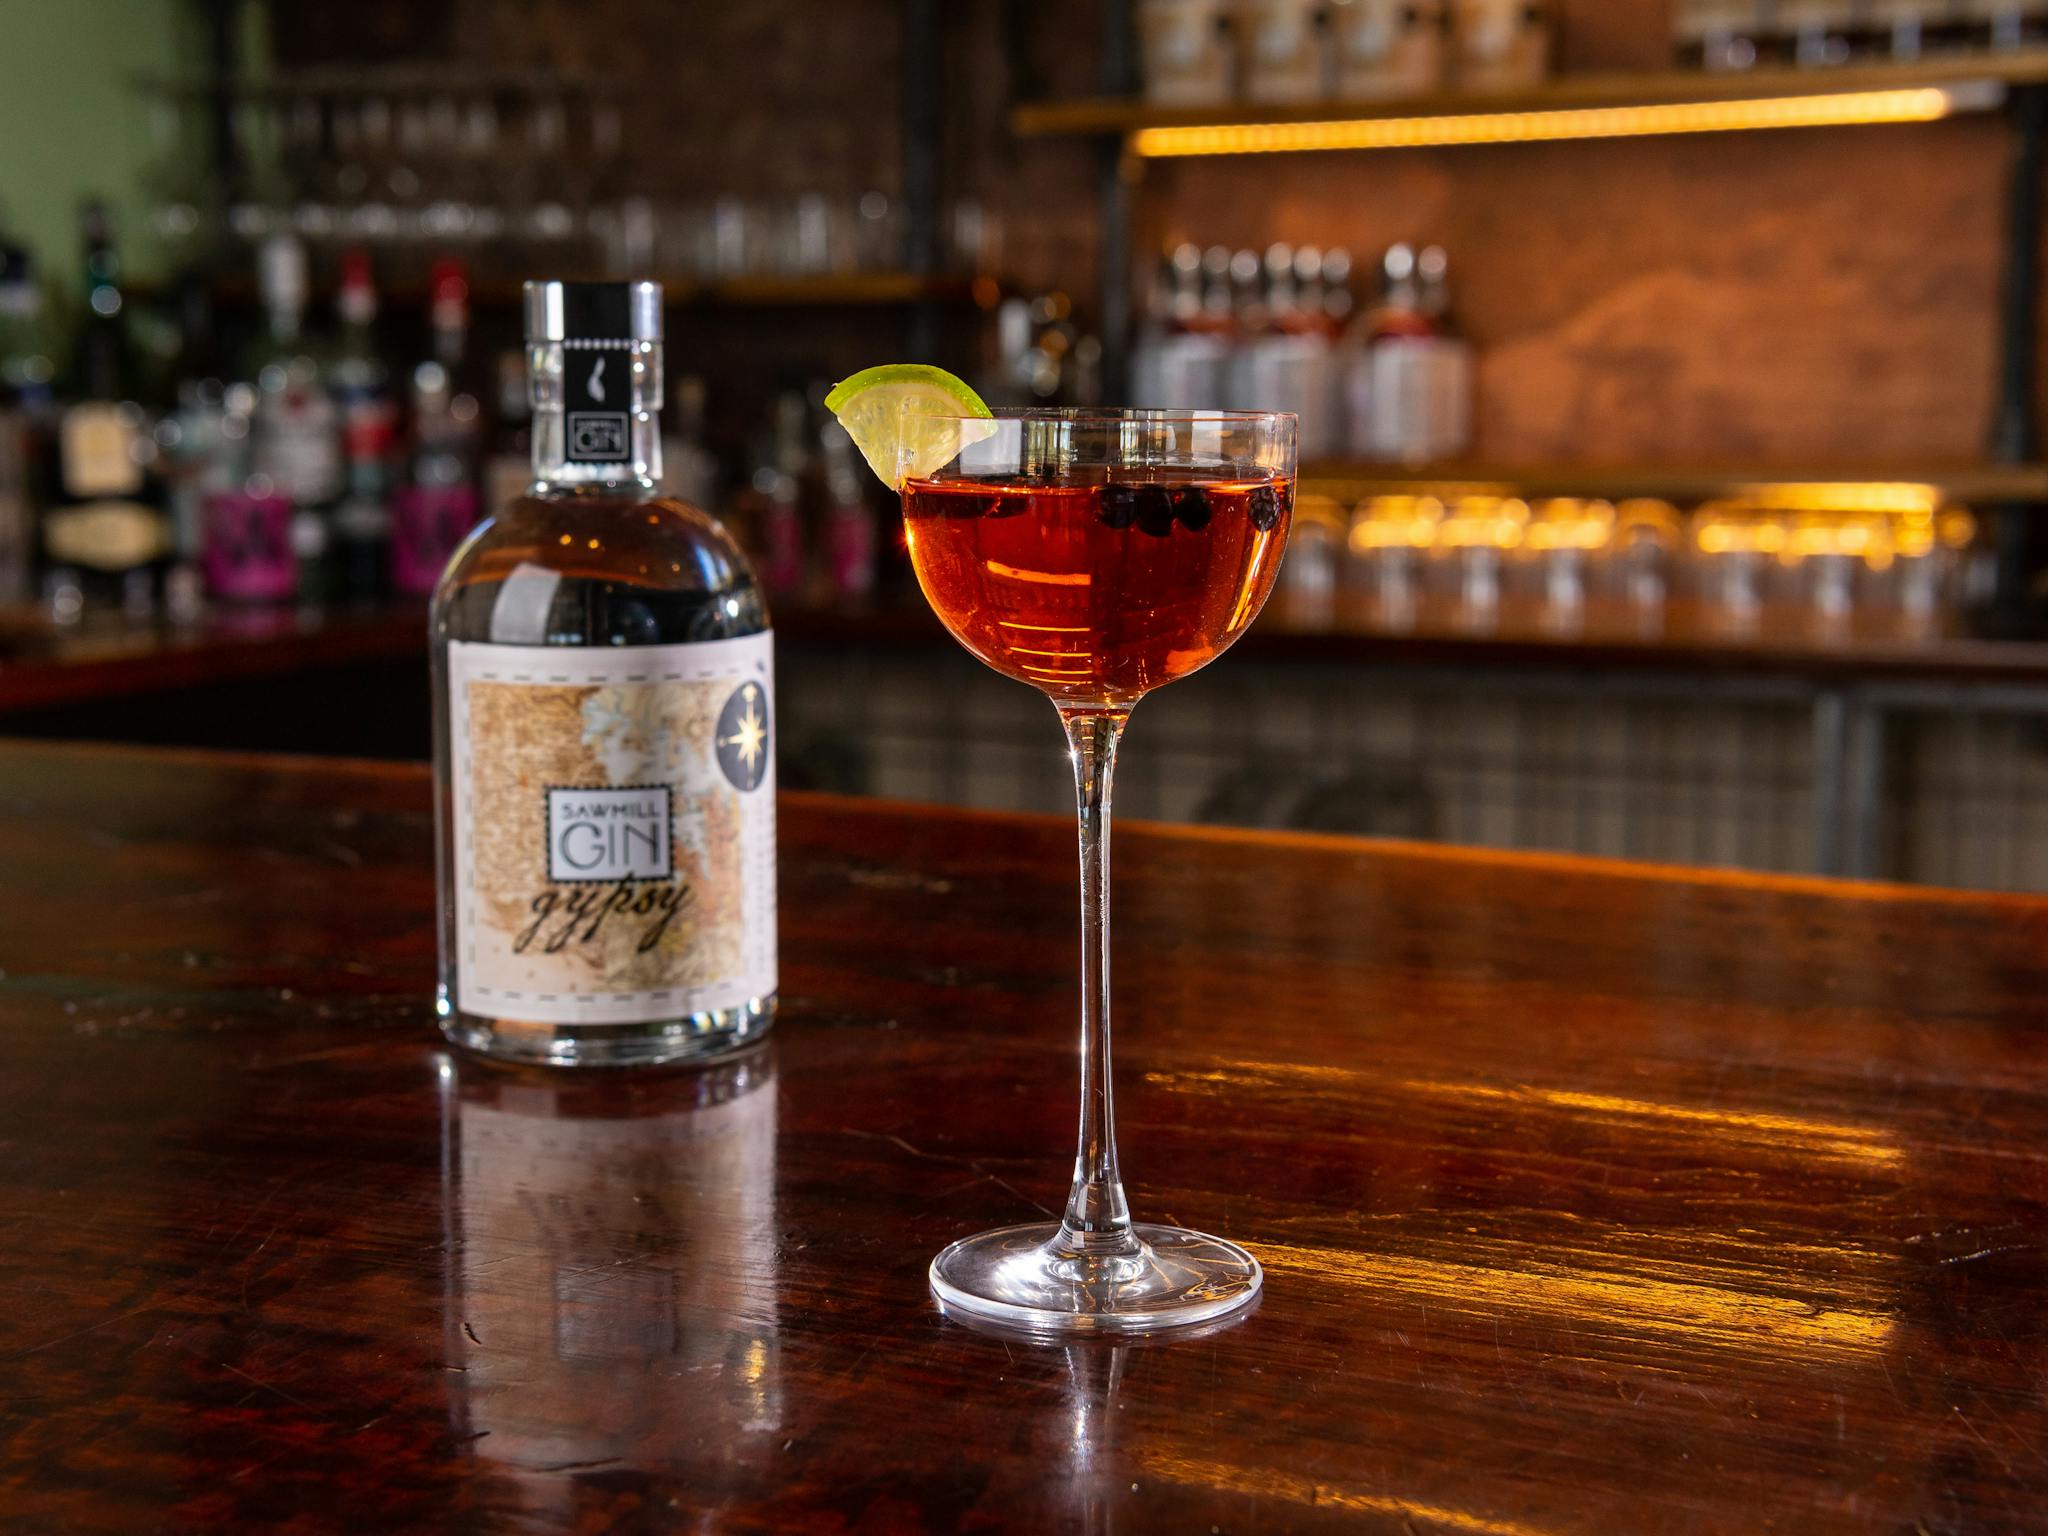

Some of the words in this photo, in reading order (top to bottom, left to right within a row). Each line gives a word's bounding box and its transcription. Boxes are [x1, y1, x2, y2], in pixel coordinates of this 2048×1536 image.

[562, 802, 660, 819] SAWMILL
[559, 821, 661, 870] GIN
[514, 870, 691, 954] gypsy
